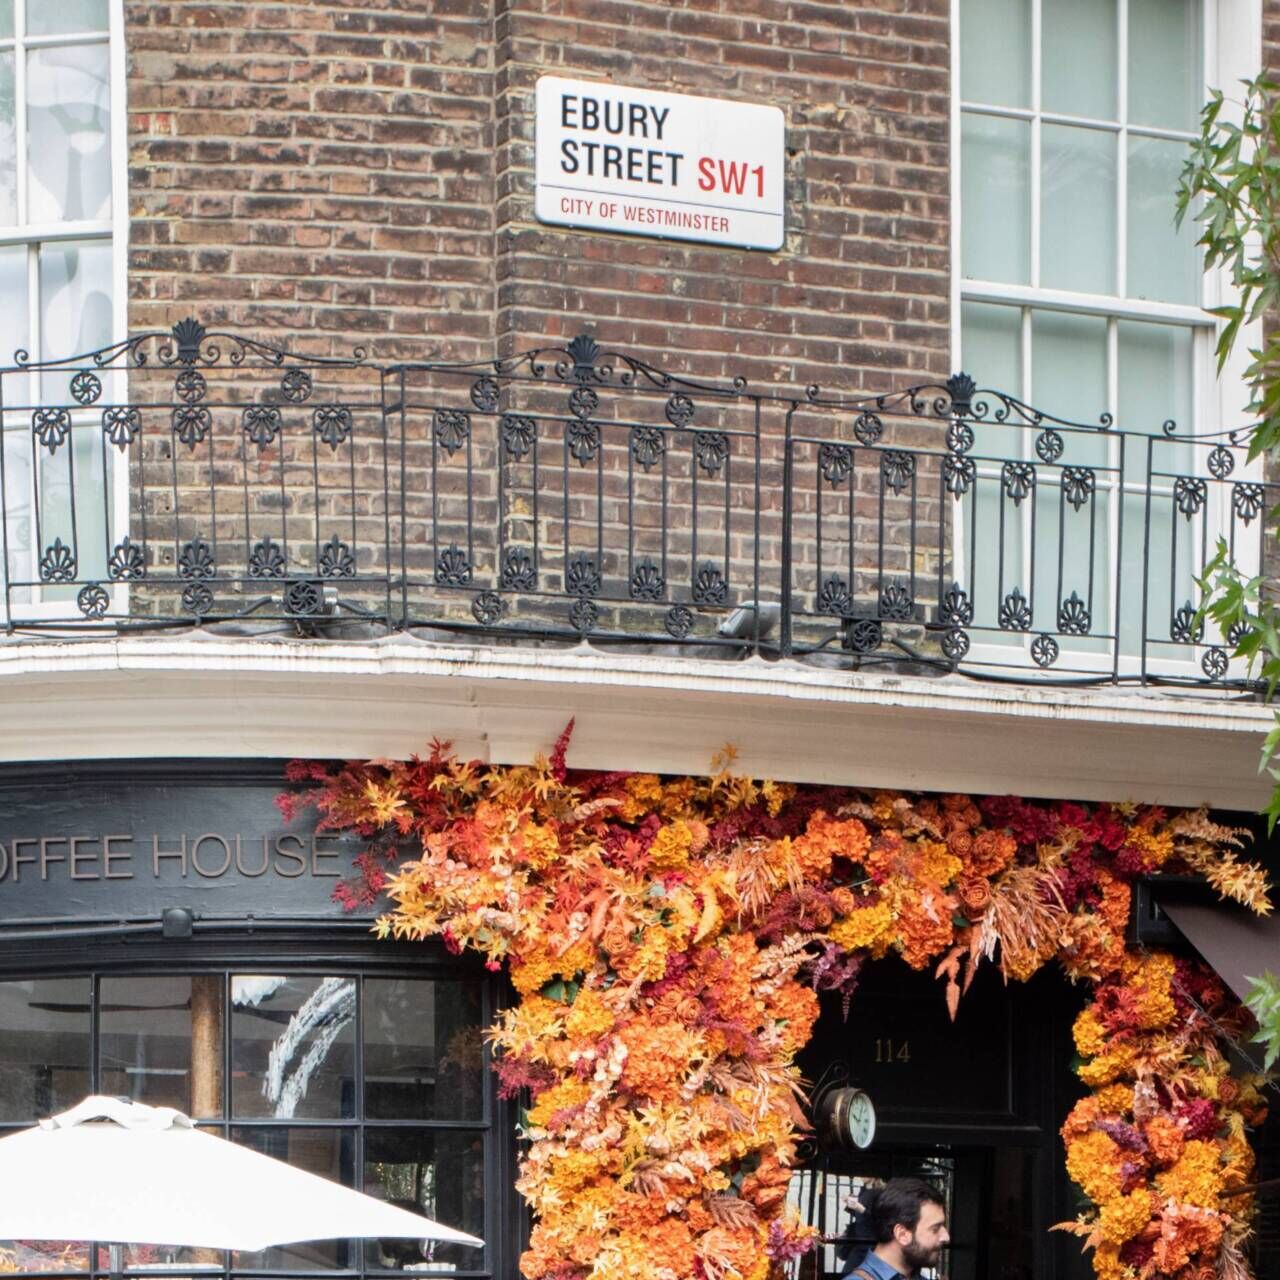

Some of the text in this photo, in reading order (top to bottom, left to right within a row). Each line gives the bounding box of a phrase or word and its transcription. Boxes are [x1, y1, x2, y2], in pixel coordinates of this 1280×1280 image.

[561, 94, 670, 140] EBURY
[561, 139, 764, 198] STREET SW1
[561, 197, 729, 233] CITY OF WESTMINSTER
[153, 832, 342, 877] HOUSE
[874, 1038, 912, 1063] 114
